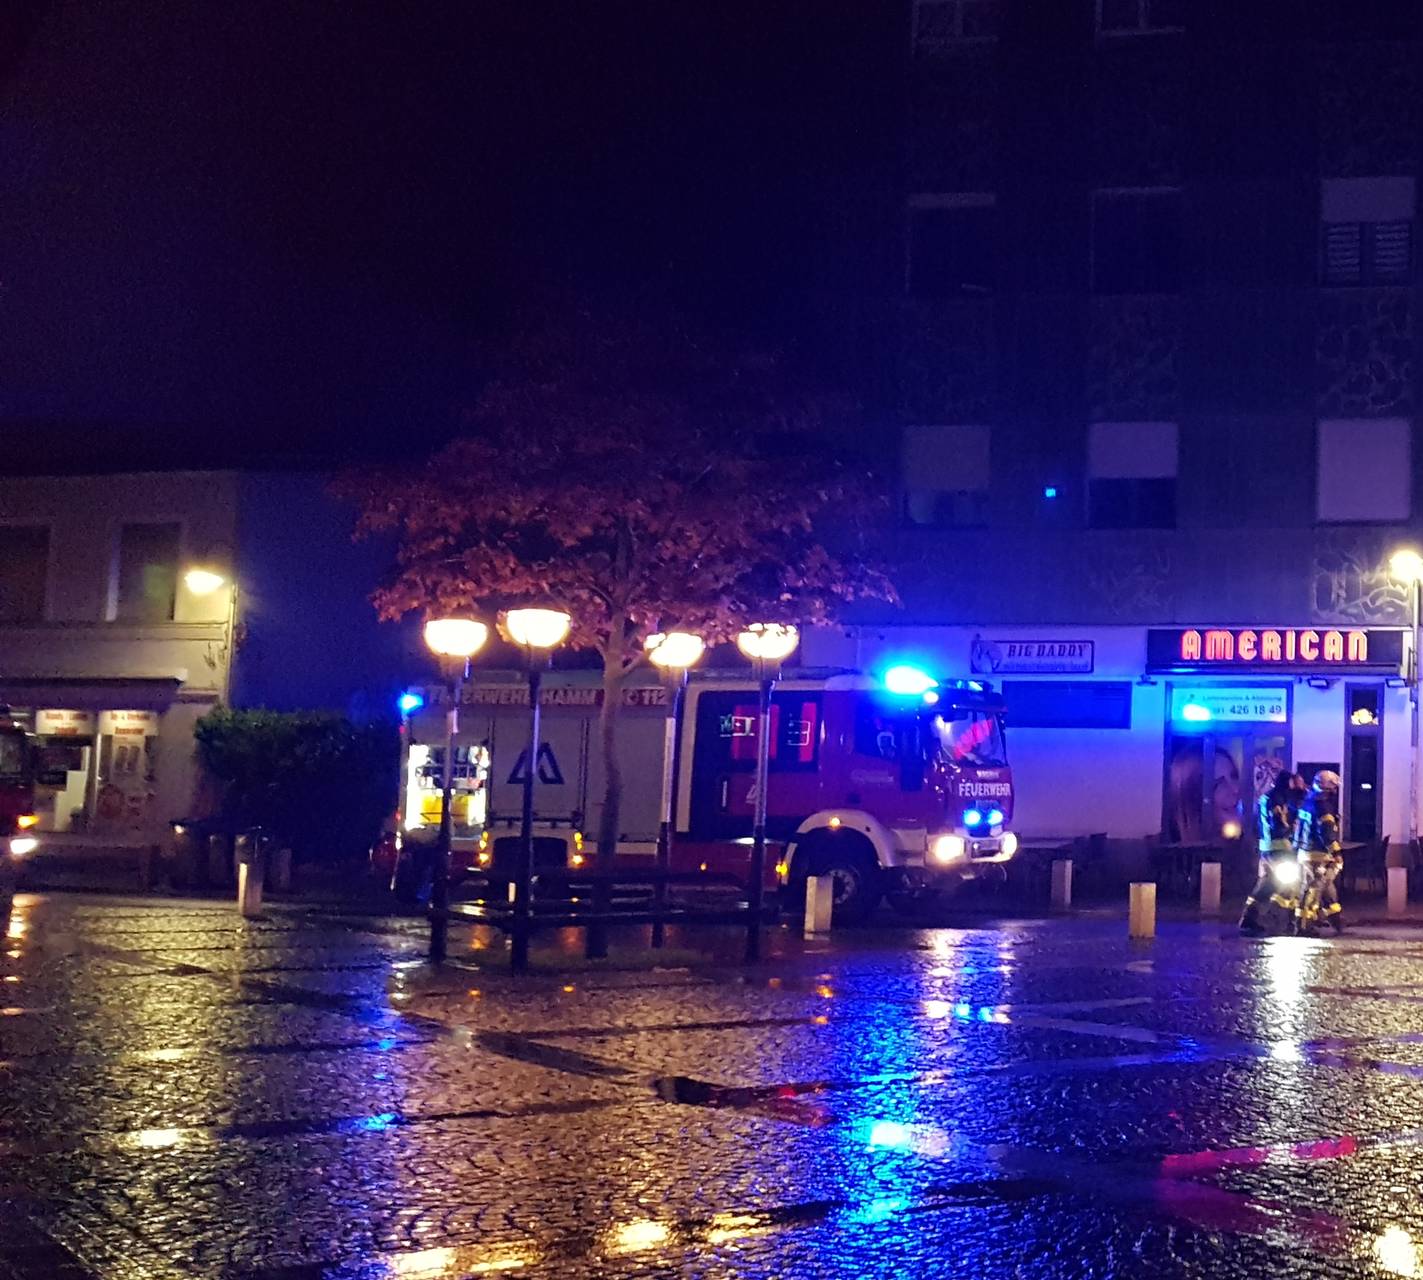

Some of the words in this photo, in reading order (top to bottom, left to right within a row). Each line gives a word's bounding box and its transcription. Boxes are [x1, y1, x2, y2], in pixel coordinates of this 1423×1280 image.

[1007, 644, 1034, 657] BIG
[1037, 644, 1088, 657] DADDY
[1181, 629, 1369, 662] AMERICAN
[1229, 704, 1249, 715] 426
[1253, 704, 1266, 715] 18
[1269, 704, 1282, 715] 49
[958, 782, 1012, 798] FEUERWEHR
